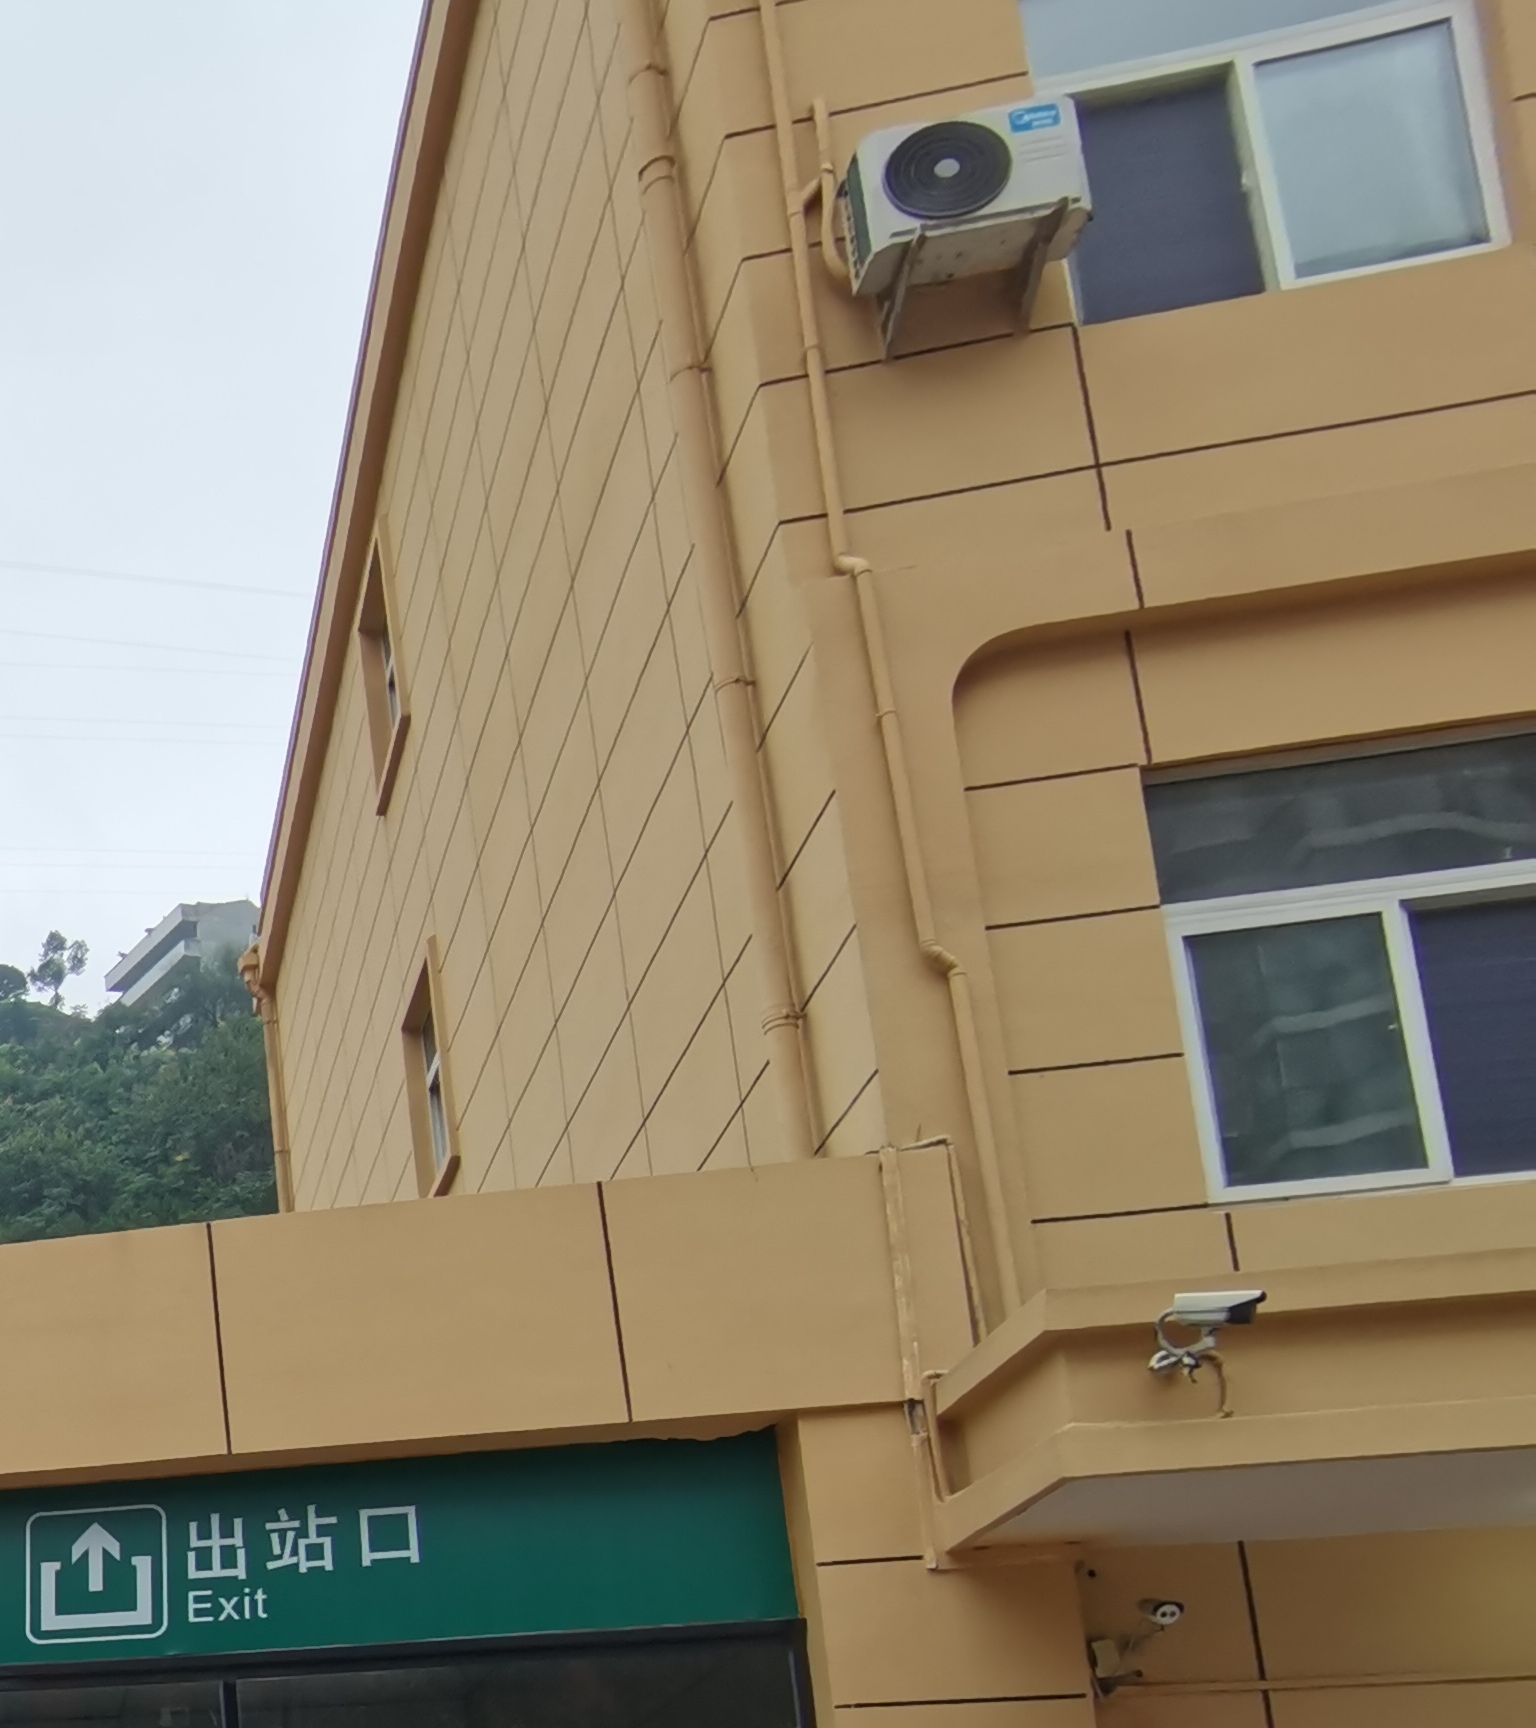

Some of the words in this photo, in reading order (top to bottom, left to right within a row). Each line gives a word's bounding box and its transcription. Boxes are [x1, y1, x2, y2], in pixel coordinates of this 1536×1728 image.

[186, 1503, 421, 1580] 出站口
[187, 1587, 268, 1623] Exit
